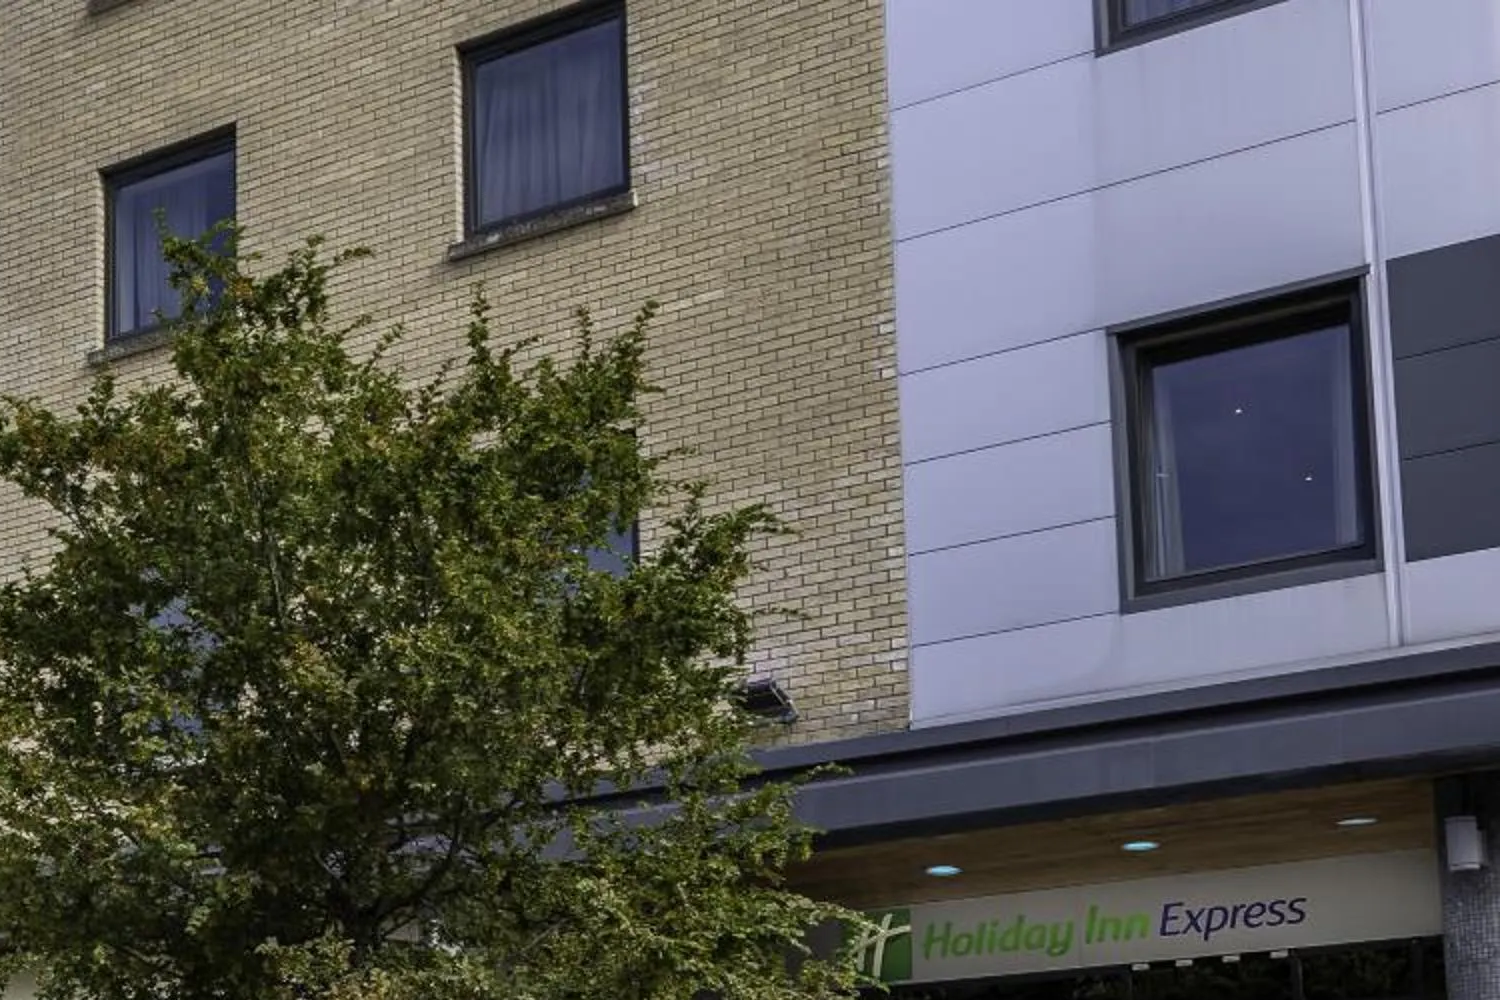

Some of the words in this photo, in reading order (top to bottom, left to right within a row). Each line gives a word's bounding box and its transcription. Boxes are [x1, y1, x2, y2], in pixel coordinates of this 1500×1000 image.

[922, 914, 1077, 960] Holiday
[1085, 905, 1151, 945] Inn
[1159, 897, 1307, 940] Express
